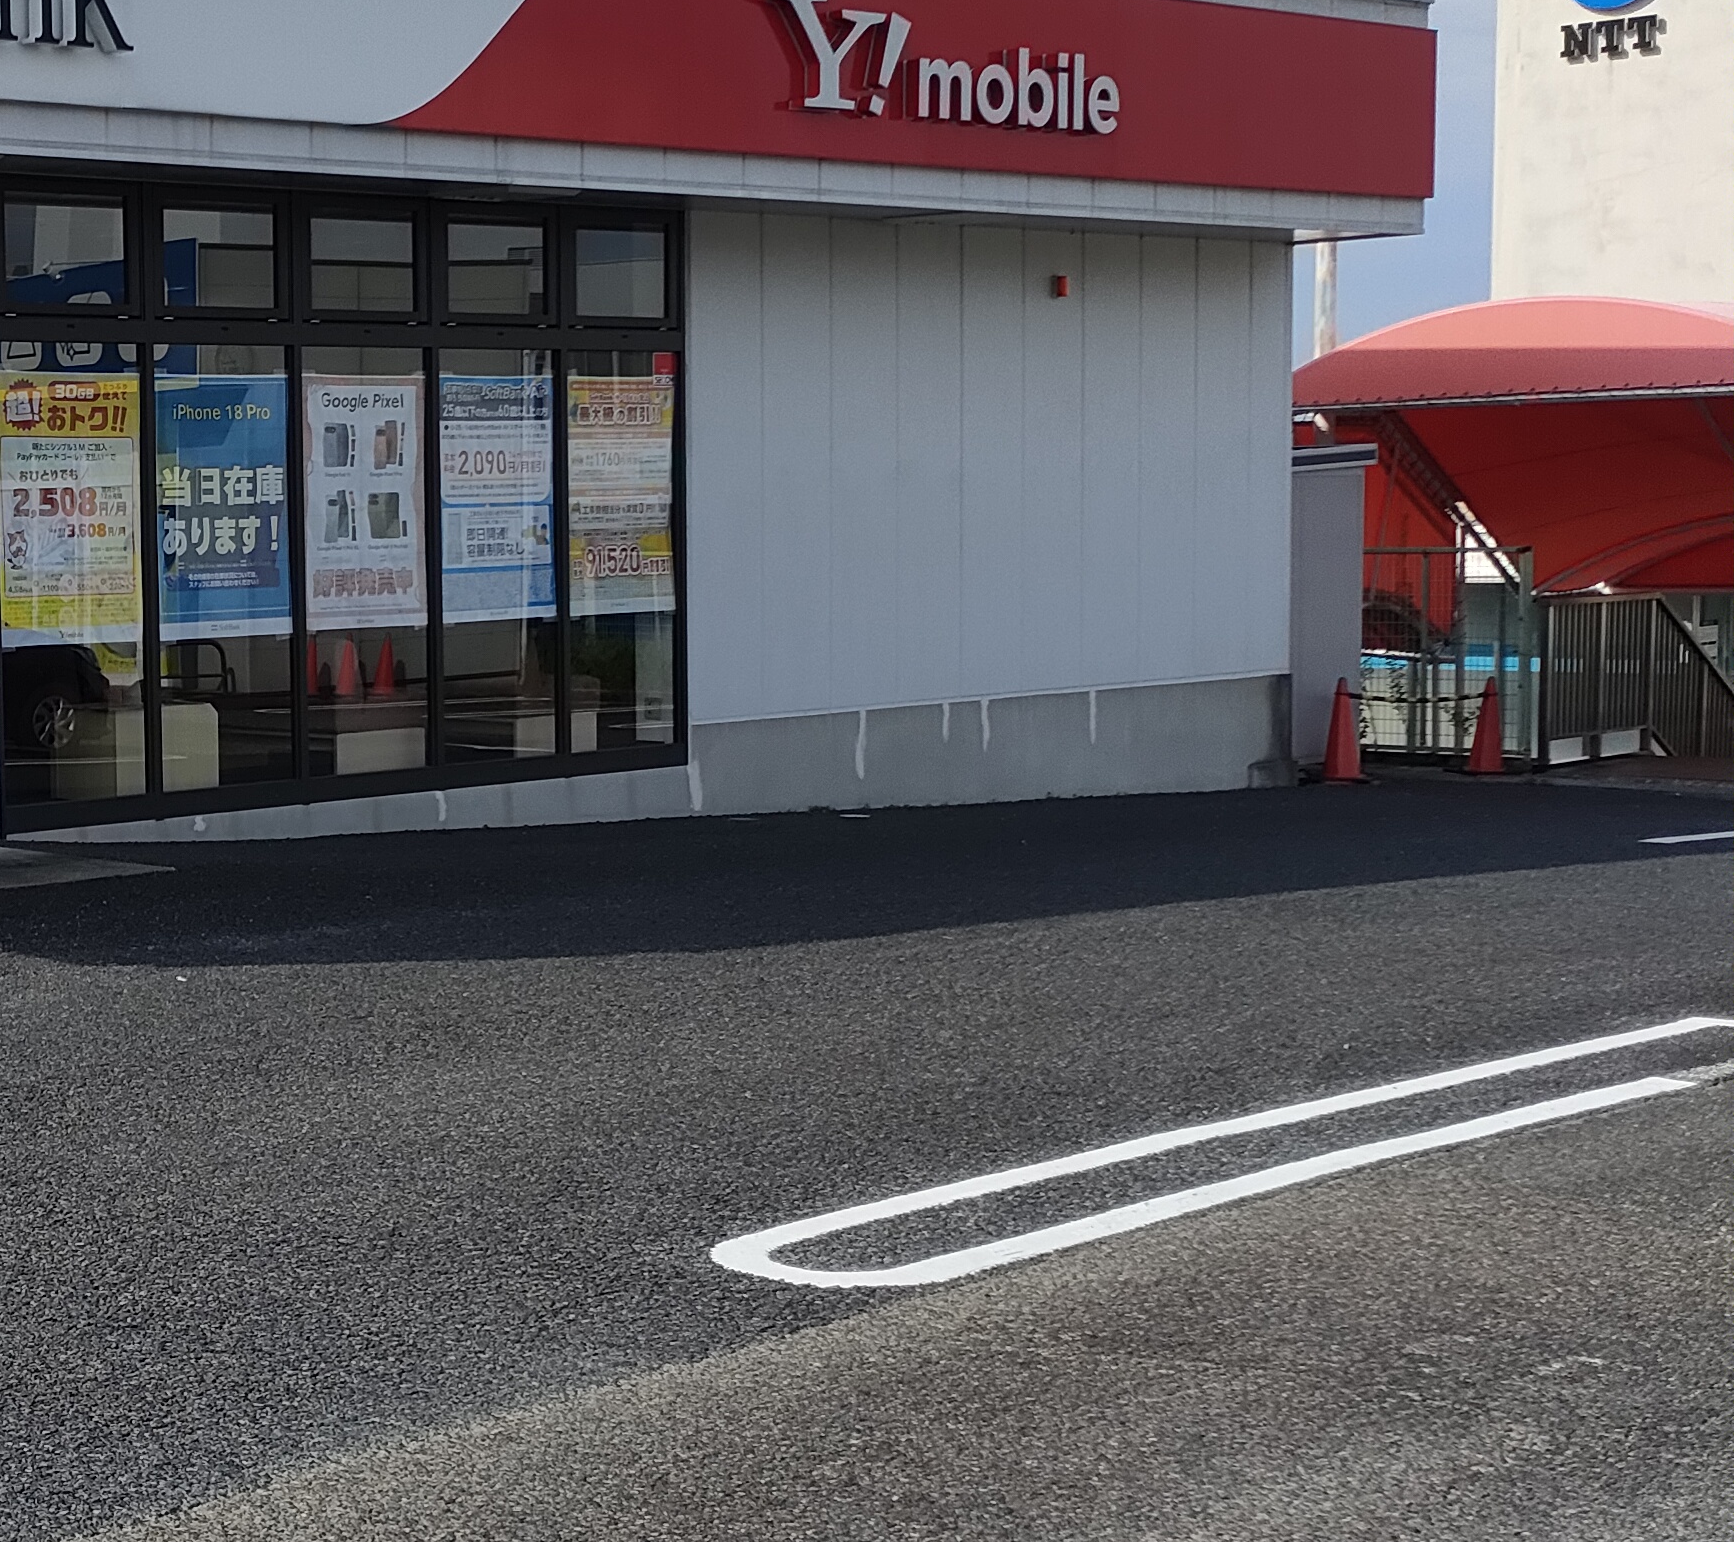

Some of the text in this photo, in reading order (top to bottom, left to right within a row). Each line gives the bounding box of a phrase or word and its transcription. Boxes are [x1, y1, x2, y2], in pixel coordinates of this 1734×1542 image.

[1560, 14, 1666, 64] NTT
[55, 383, 94, 400] 30GB
[321, 392, 404, 412] Google Pixel
[173, 404, 270, 421] iPhone 18 Pro
[19, 468, 79, 482] おひとりでも
[458, 450, 506, 477] 2,090
[163, 465, 284, 507] 当日在庫
[13, 487, 97, 519] 2,508
[313, 567, 413, 598] 好評発売中
